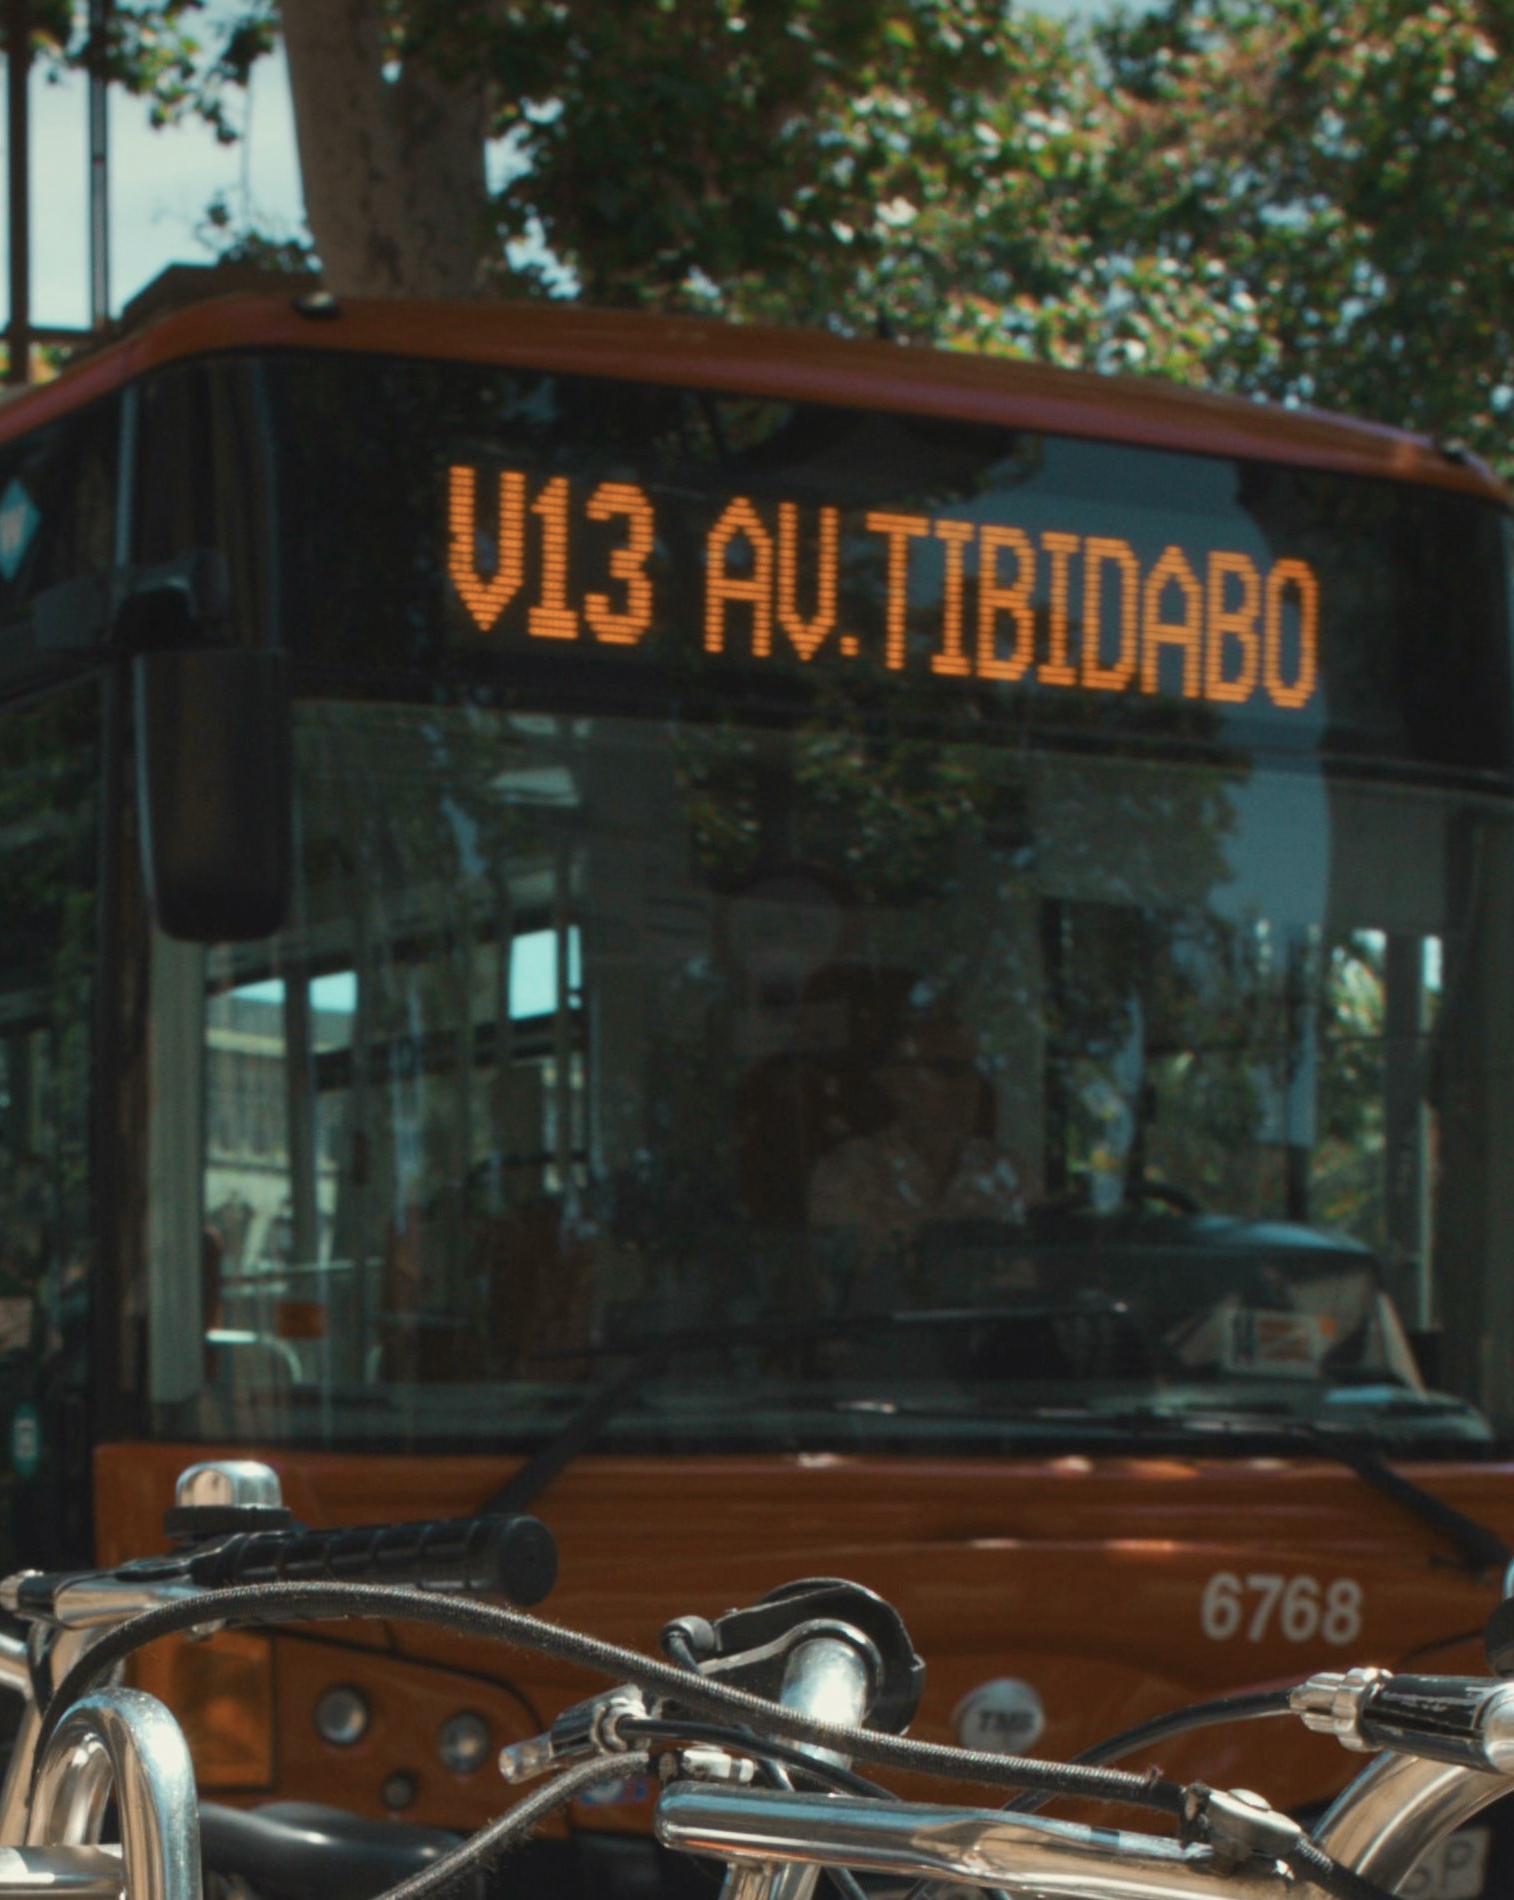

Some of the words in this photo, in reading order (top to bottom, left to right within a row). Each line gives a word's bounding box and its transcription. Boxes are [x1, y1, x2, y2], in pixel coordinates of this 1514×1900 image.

[448, 466, 654, 646] V13
[704, 496, 1319, 709] AV.TIBIDABO
[1201, 1572, 1363, 1645] 6768
